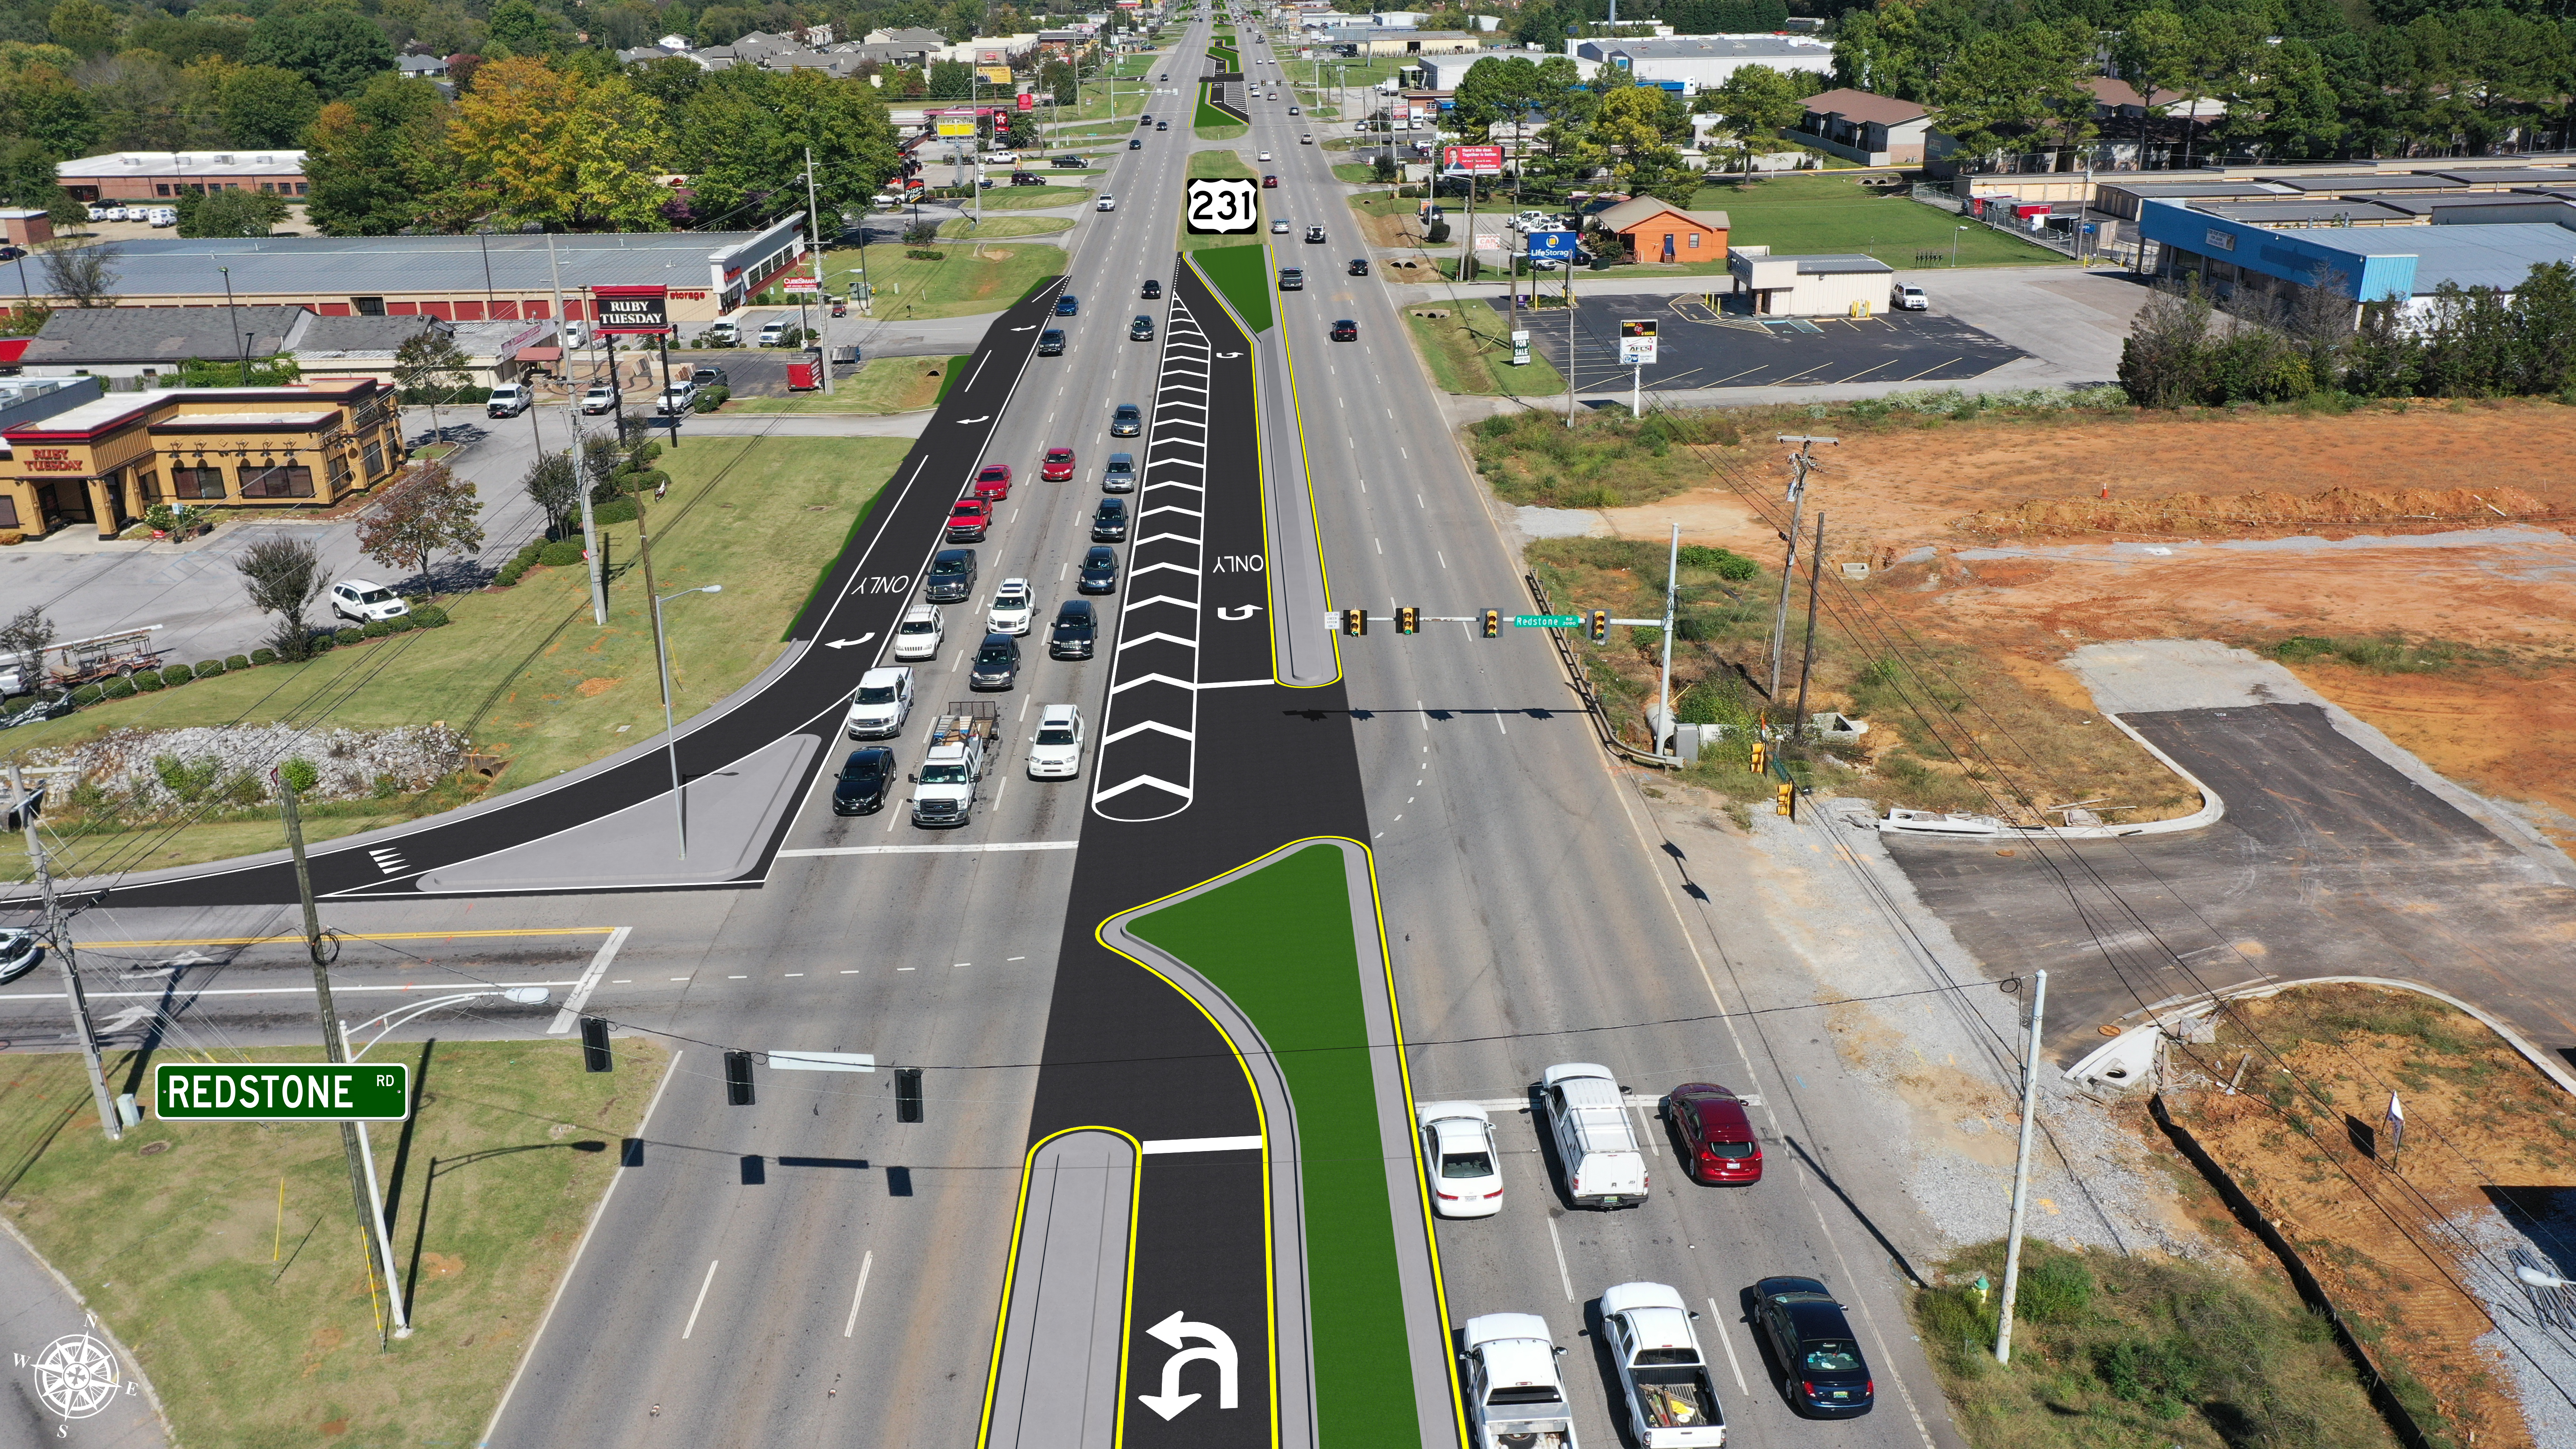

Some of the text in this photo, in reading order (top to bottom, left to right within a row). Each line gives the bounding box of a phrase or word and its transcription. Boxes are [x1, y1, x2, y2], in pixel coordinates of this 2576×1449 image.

[905, 186, 924, 199] Pizza
[909, 192, 922, 201] Hut
[1531, 249, 1573, 257] LifeStorag
[670, 291, 705, 301] storage
[610, 301, 649, 312] RUBY
[599, 313, 662, 324] TUESDAY
[1514, 348, 1528, 356] SALE
[32, 449, 68, 459] RUBY
[23, 460, 83, 471] TUESDAY
[1516, 617, 1558, 626] Redstone
